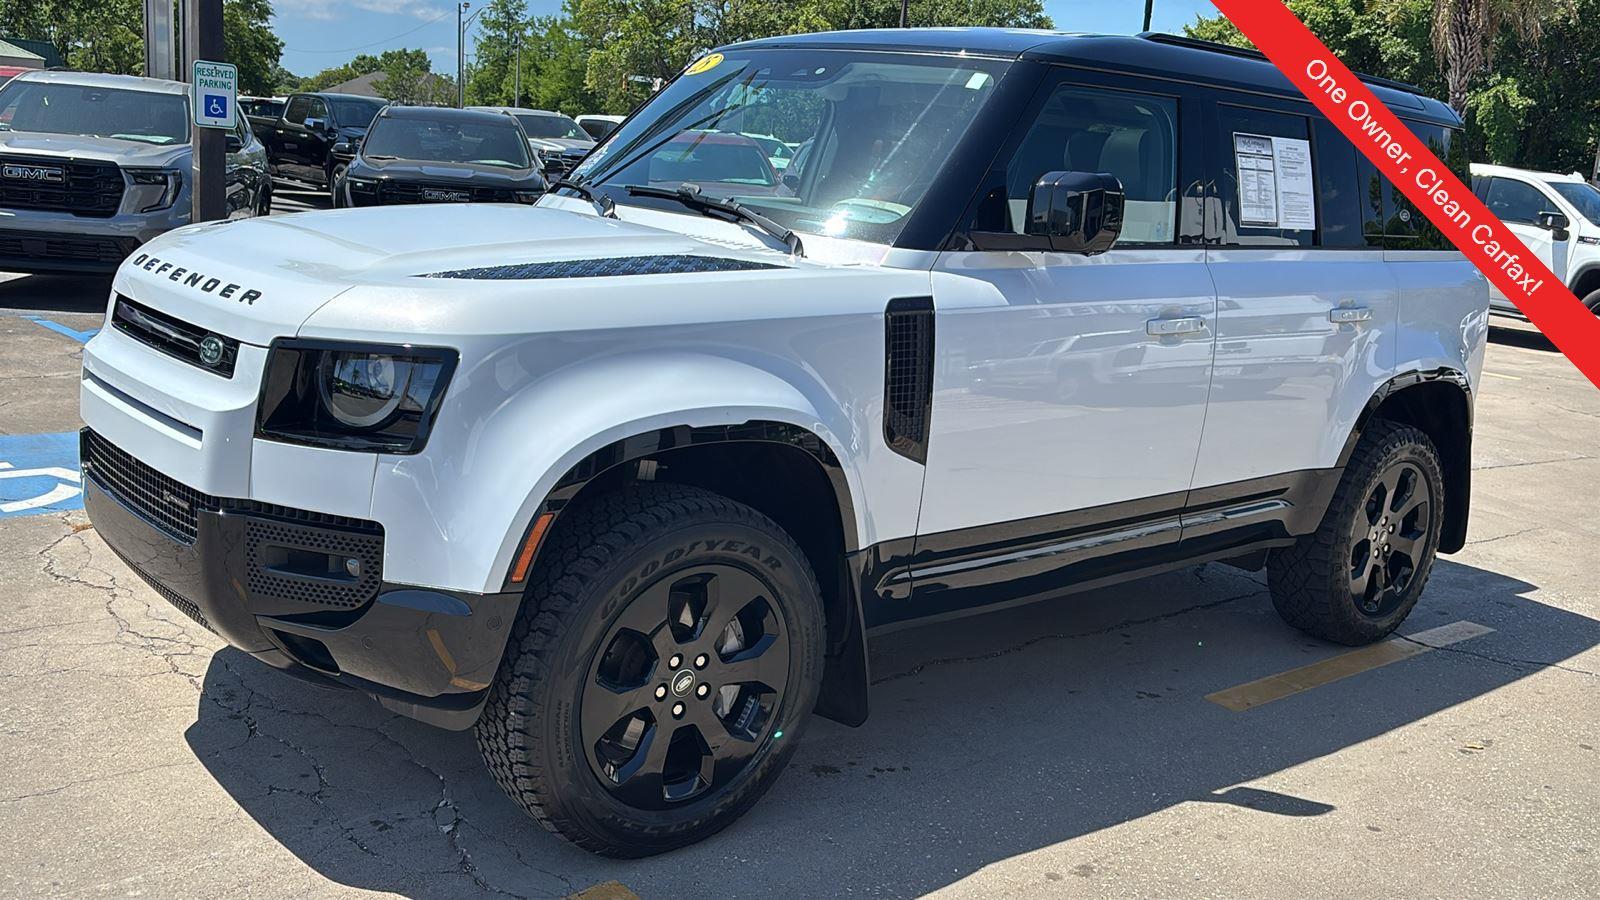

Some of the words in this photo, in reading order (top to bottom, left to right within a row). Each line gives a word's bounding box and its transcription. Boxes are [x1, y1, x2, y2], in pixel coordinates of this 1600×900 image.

[196, 67, 234, 79] RESERVED
[199, 79, 232, 90] PARKING
[3, 166, 62, 182] GMC
[424, 190, 470, 202] GMC
[132, 253, 262, 305] DEFENDER
[601, 540, 782, 619] GOODYEAR
